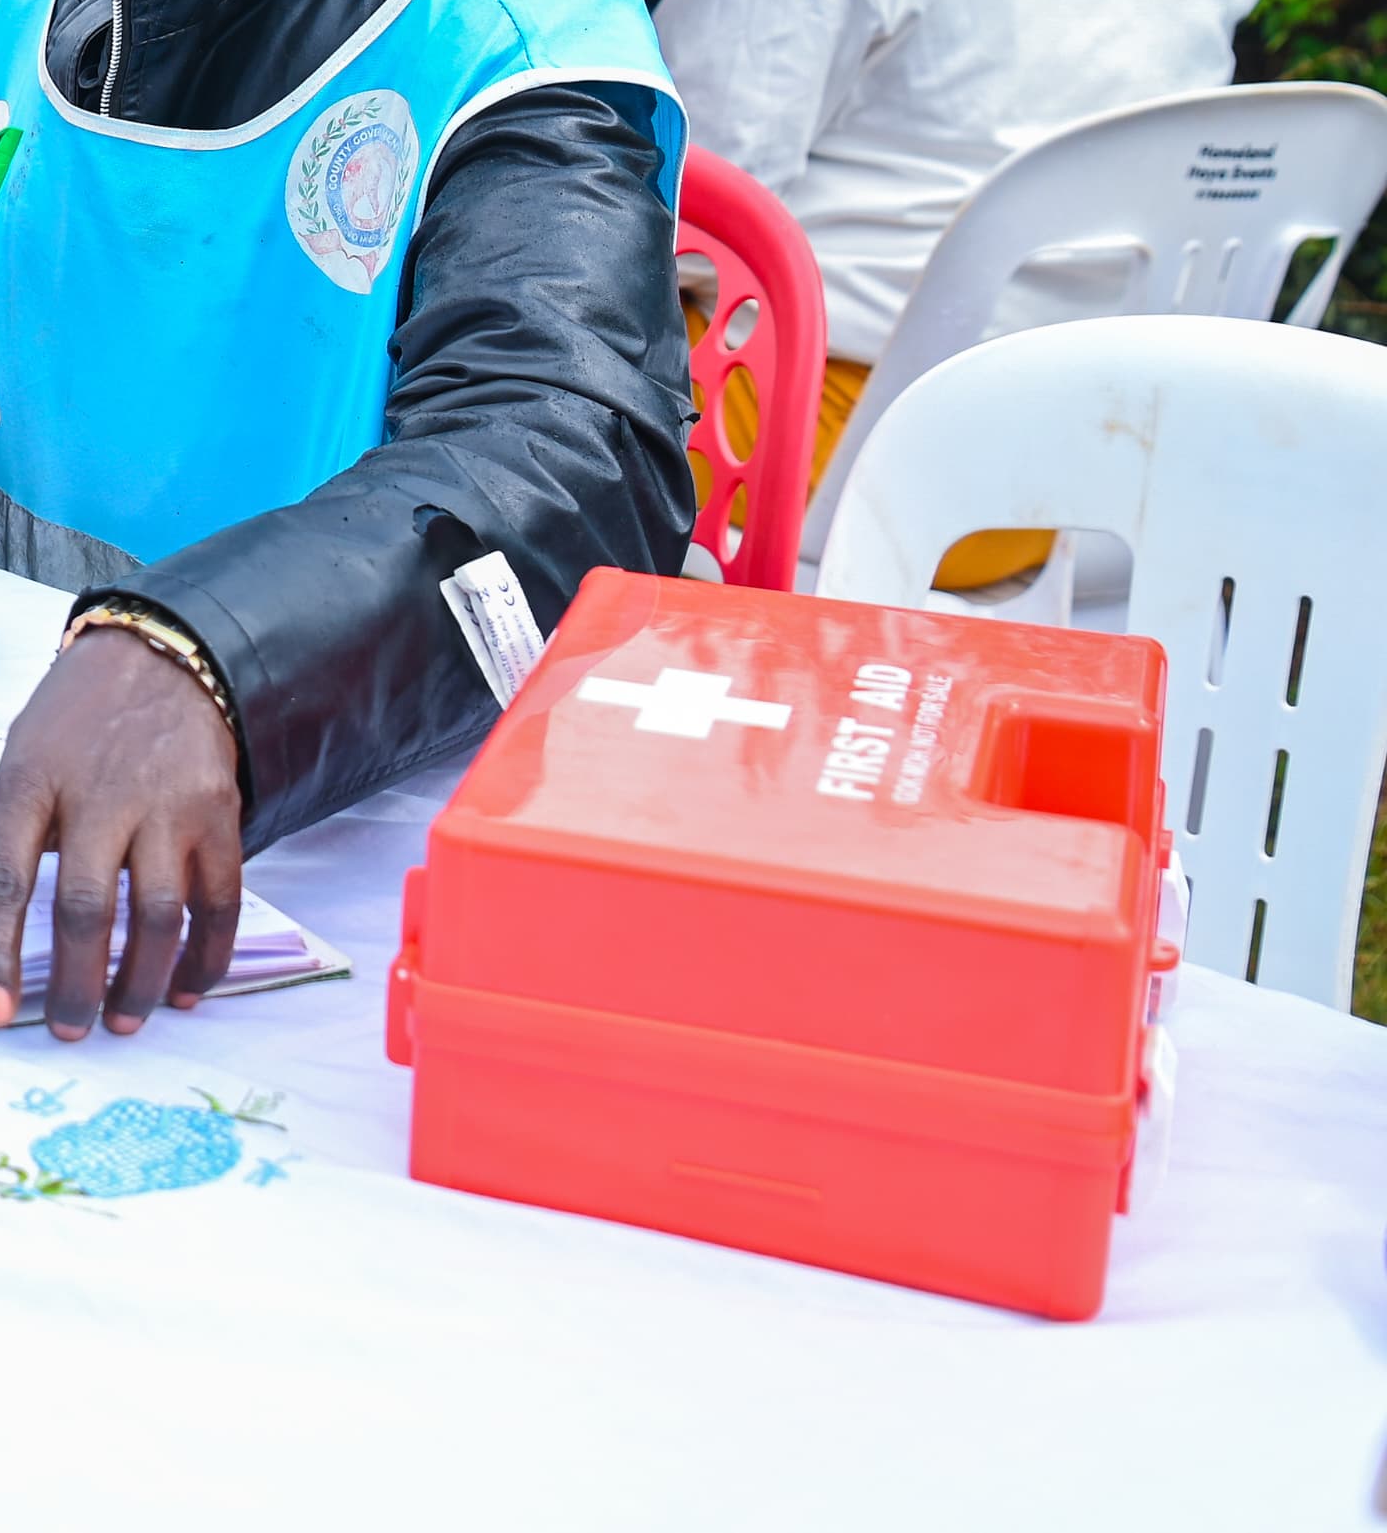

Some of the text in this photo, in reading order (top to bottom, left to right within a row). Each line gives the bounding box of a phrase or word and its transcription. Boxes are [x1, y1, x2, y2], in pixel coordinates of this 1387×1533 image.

[328, 142, 353, 191] COUNTY
[921, 674, 953, 702] SALE
[815, 663, 912, 801] FIRST AID
